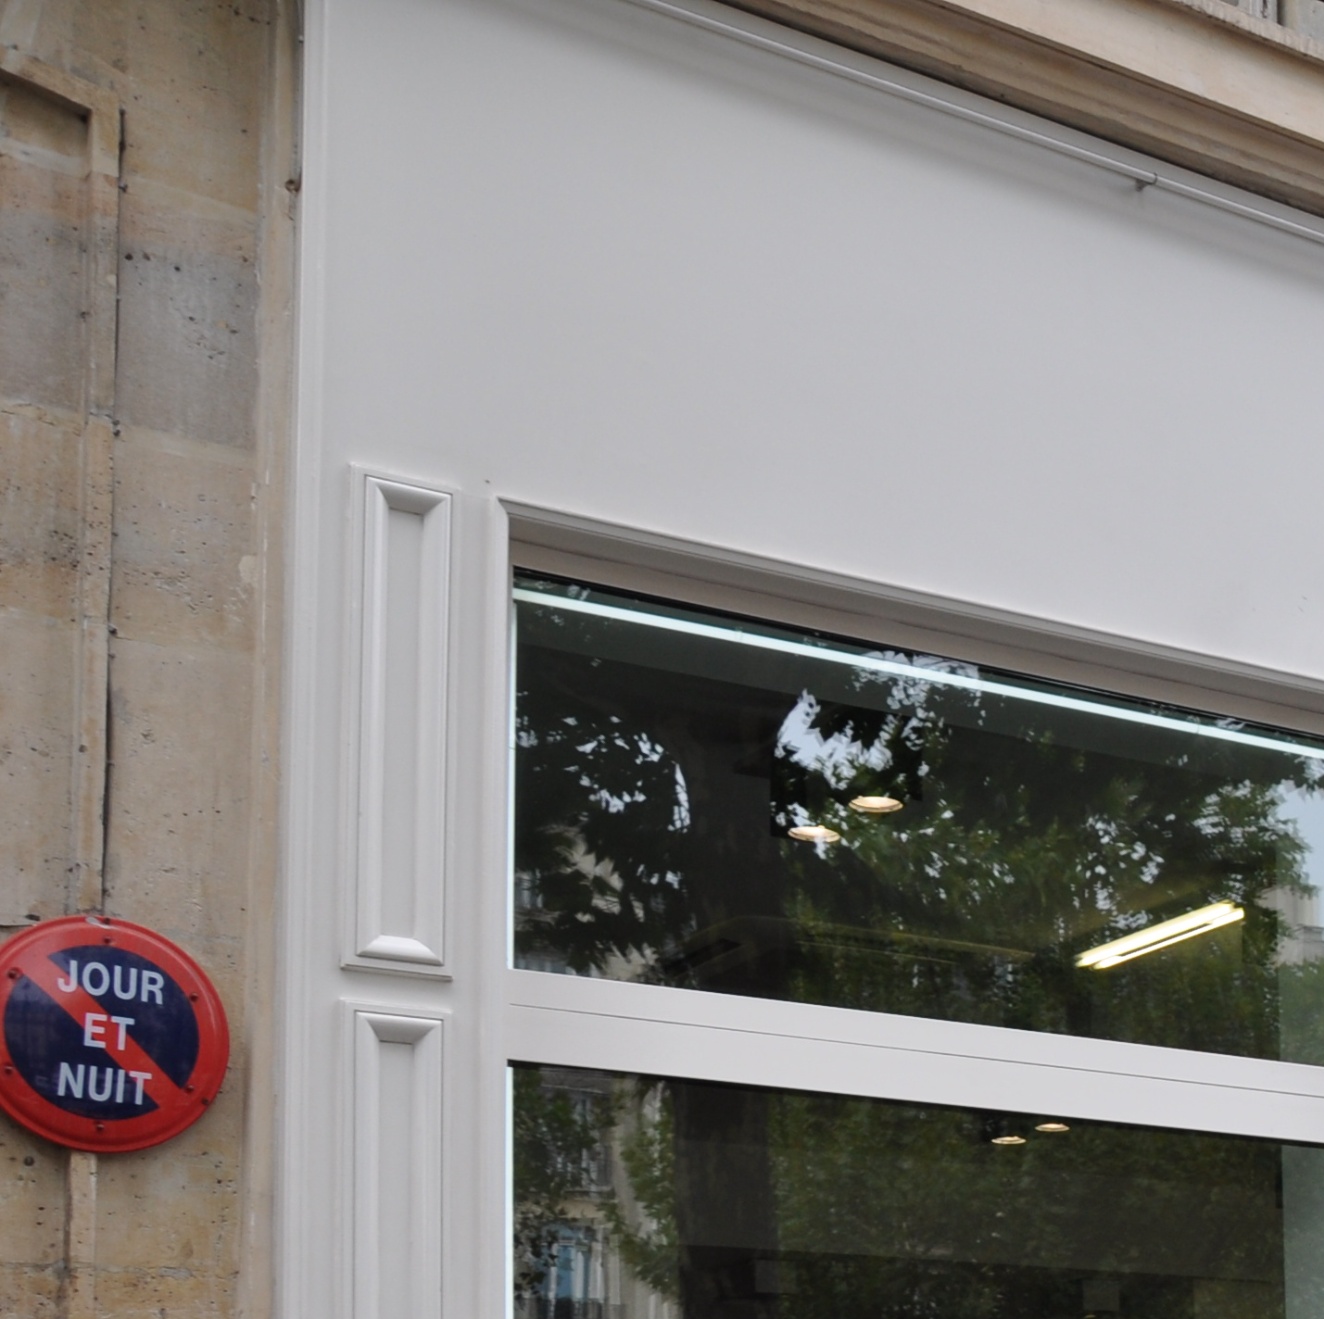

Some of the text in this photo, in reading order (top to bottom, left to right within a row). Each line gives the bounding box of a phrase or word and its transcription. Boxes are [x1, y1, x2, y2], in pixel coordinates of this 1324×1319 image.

[57, 959, 165, 1006] JOUR
[83, 1012, 136, 1051] ET
[57, 1061, 153, 1106] NUIT
